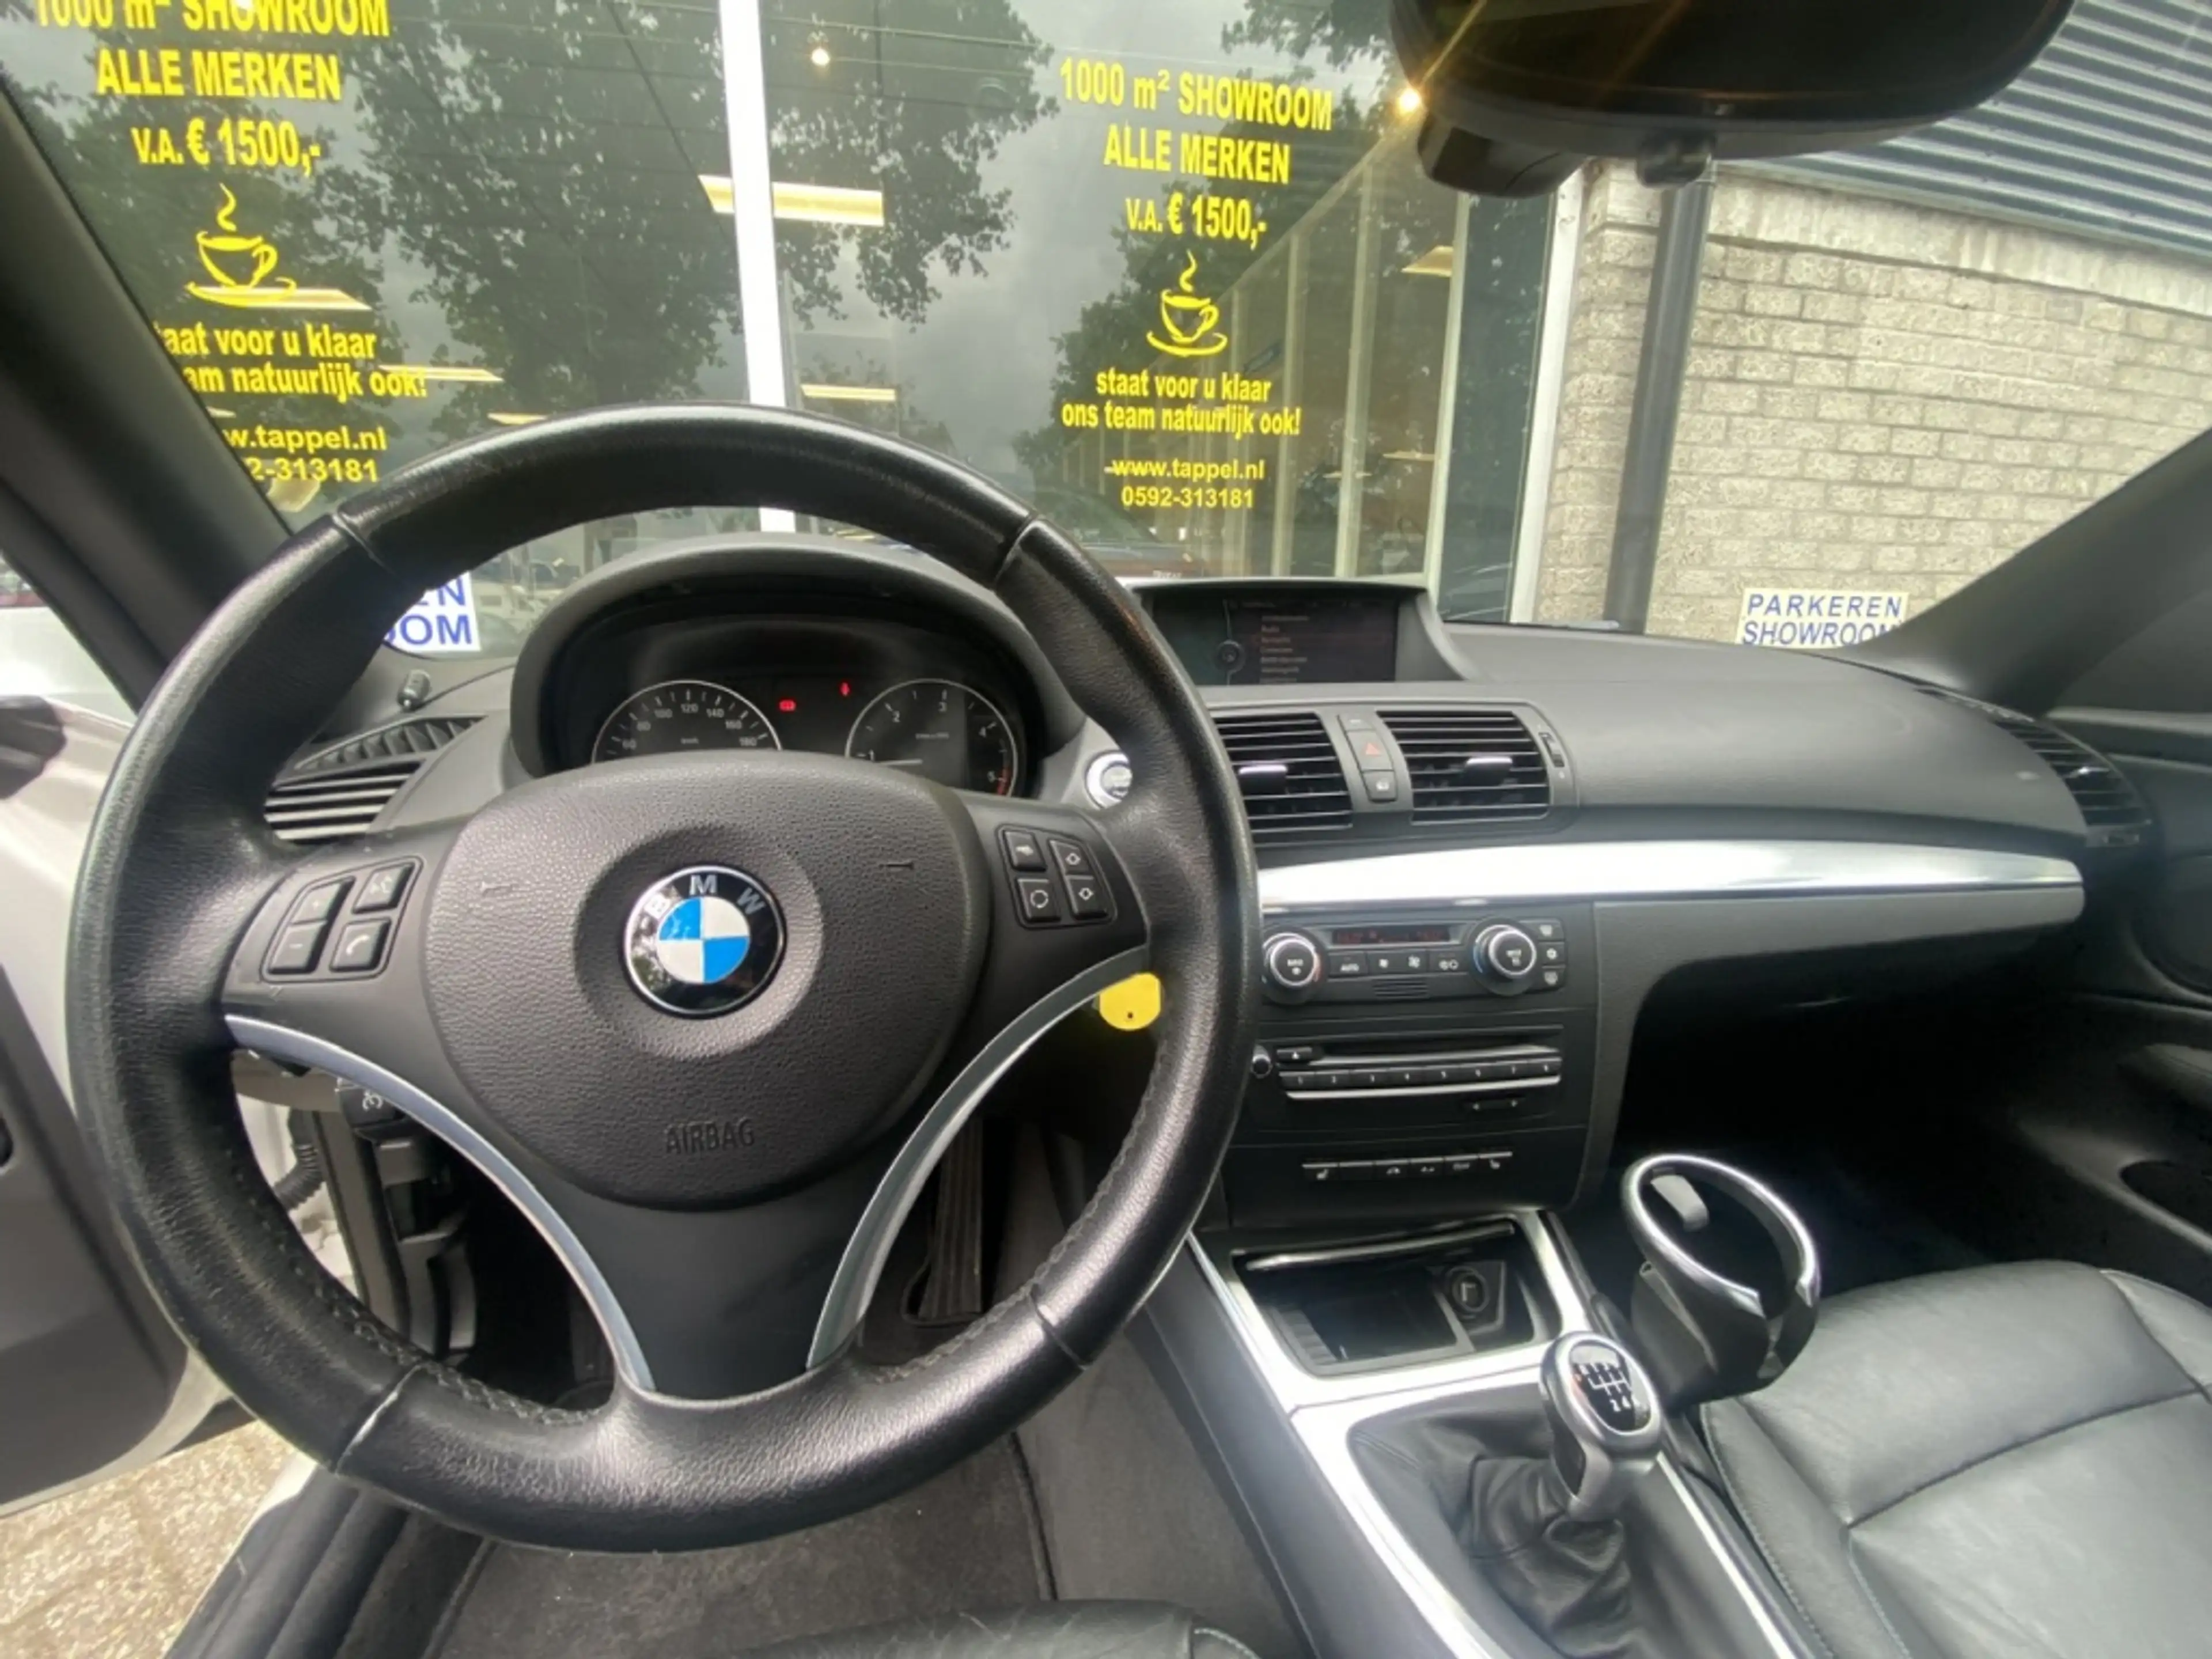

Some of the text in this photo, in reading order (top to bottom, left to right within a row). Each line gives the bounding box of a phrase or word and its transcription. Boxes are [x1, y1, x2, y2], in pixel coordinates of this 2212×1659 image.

[183, 0, 389, 36] SHOWROOM
[97, 49, 341, 100] ALLE MERKEN
[1061, 57, 1124, 105] 1000
[1178, 71, 1333, 131] SHOWROOM
[132, 118, 320, 175] V.A. € 1500,-
[1104, 123, 1290, 184] ALLE MERKEN
[1126, 192, 1267, 250] V.A. € 1500,-
[214, 328, 275, 355] voor
[283, 330, 301, 357] u
[305, 322, 377, 360] klaar
[231, 361, 362, 403] natuurlijk
[369, 372, 427, 397] ook!
[1096, 368, 1271, 402] staat voor u klaar
[1062, 401, 1301, 439] ons team natuurlijk ook!
[1111, 458, 1265, 481] www.tappel.nl
[1121, 486, 1254, 508] 0592-313181
[1747, 593, 1902, 618] PARKEREN
[643, 874, 766, 920] BMW
[665, 1118, 755, 1154] AIRBAG
